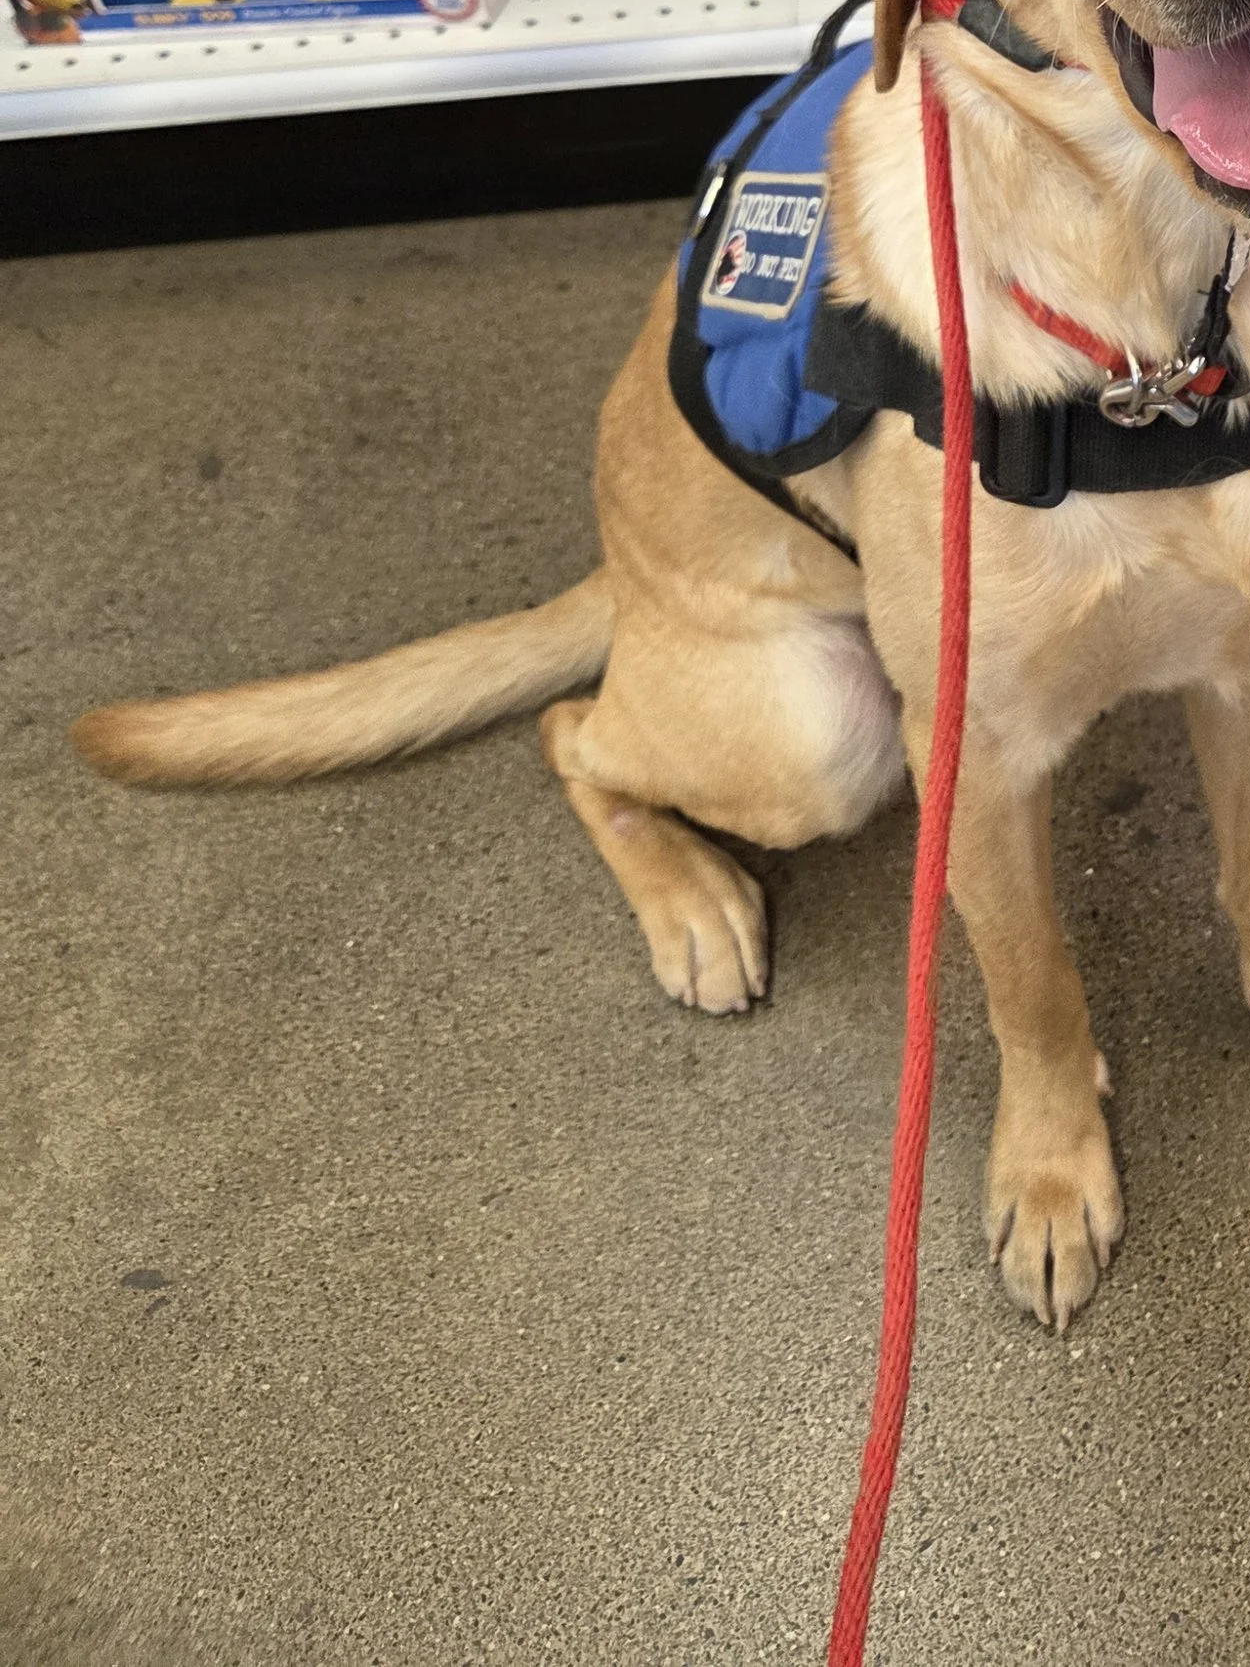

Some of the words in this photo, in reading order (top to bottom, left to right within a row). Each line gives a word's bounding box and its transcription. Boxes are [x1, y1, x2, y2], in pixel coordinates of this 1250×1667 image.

[734, 193, 822, 236] WORKING
[756, 254, 781, 278] NOT
[777, 257, 803, 282] PET
